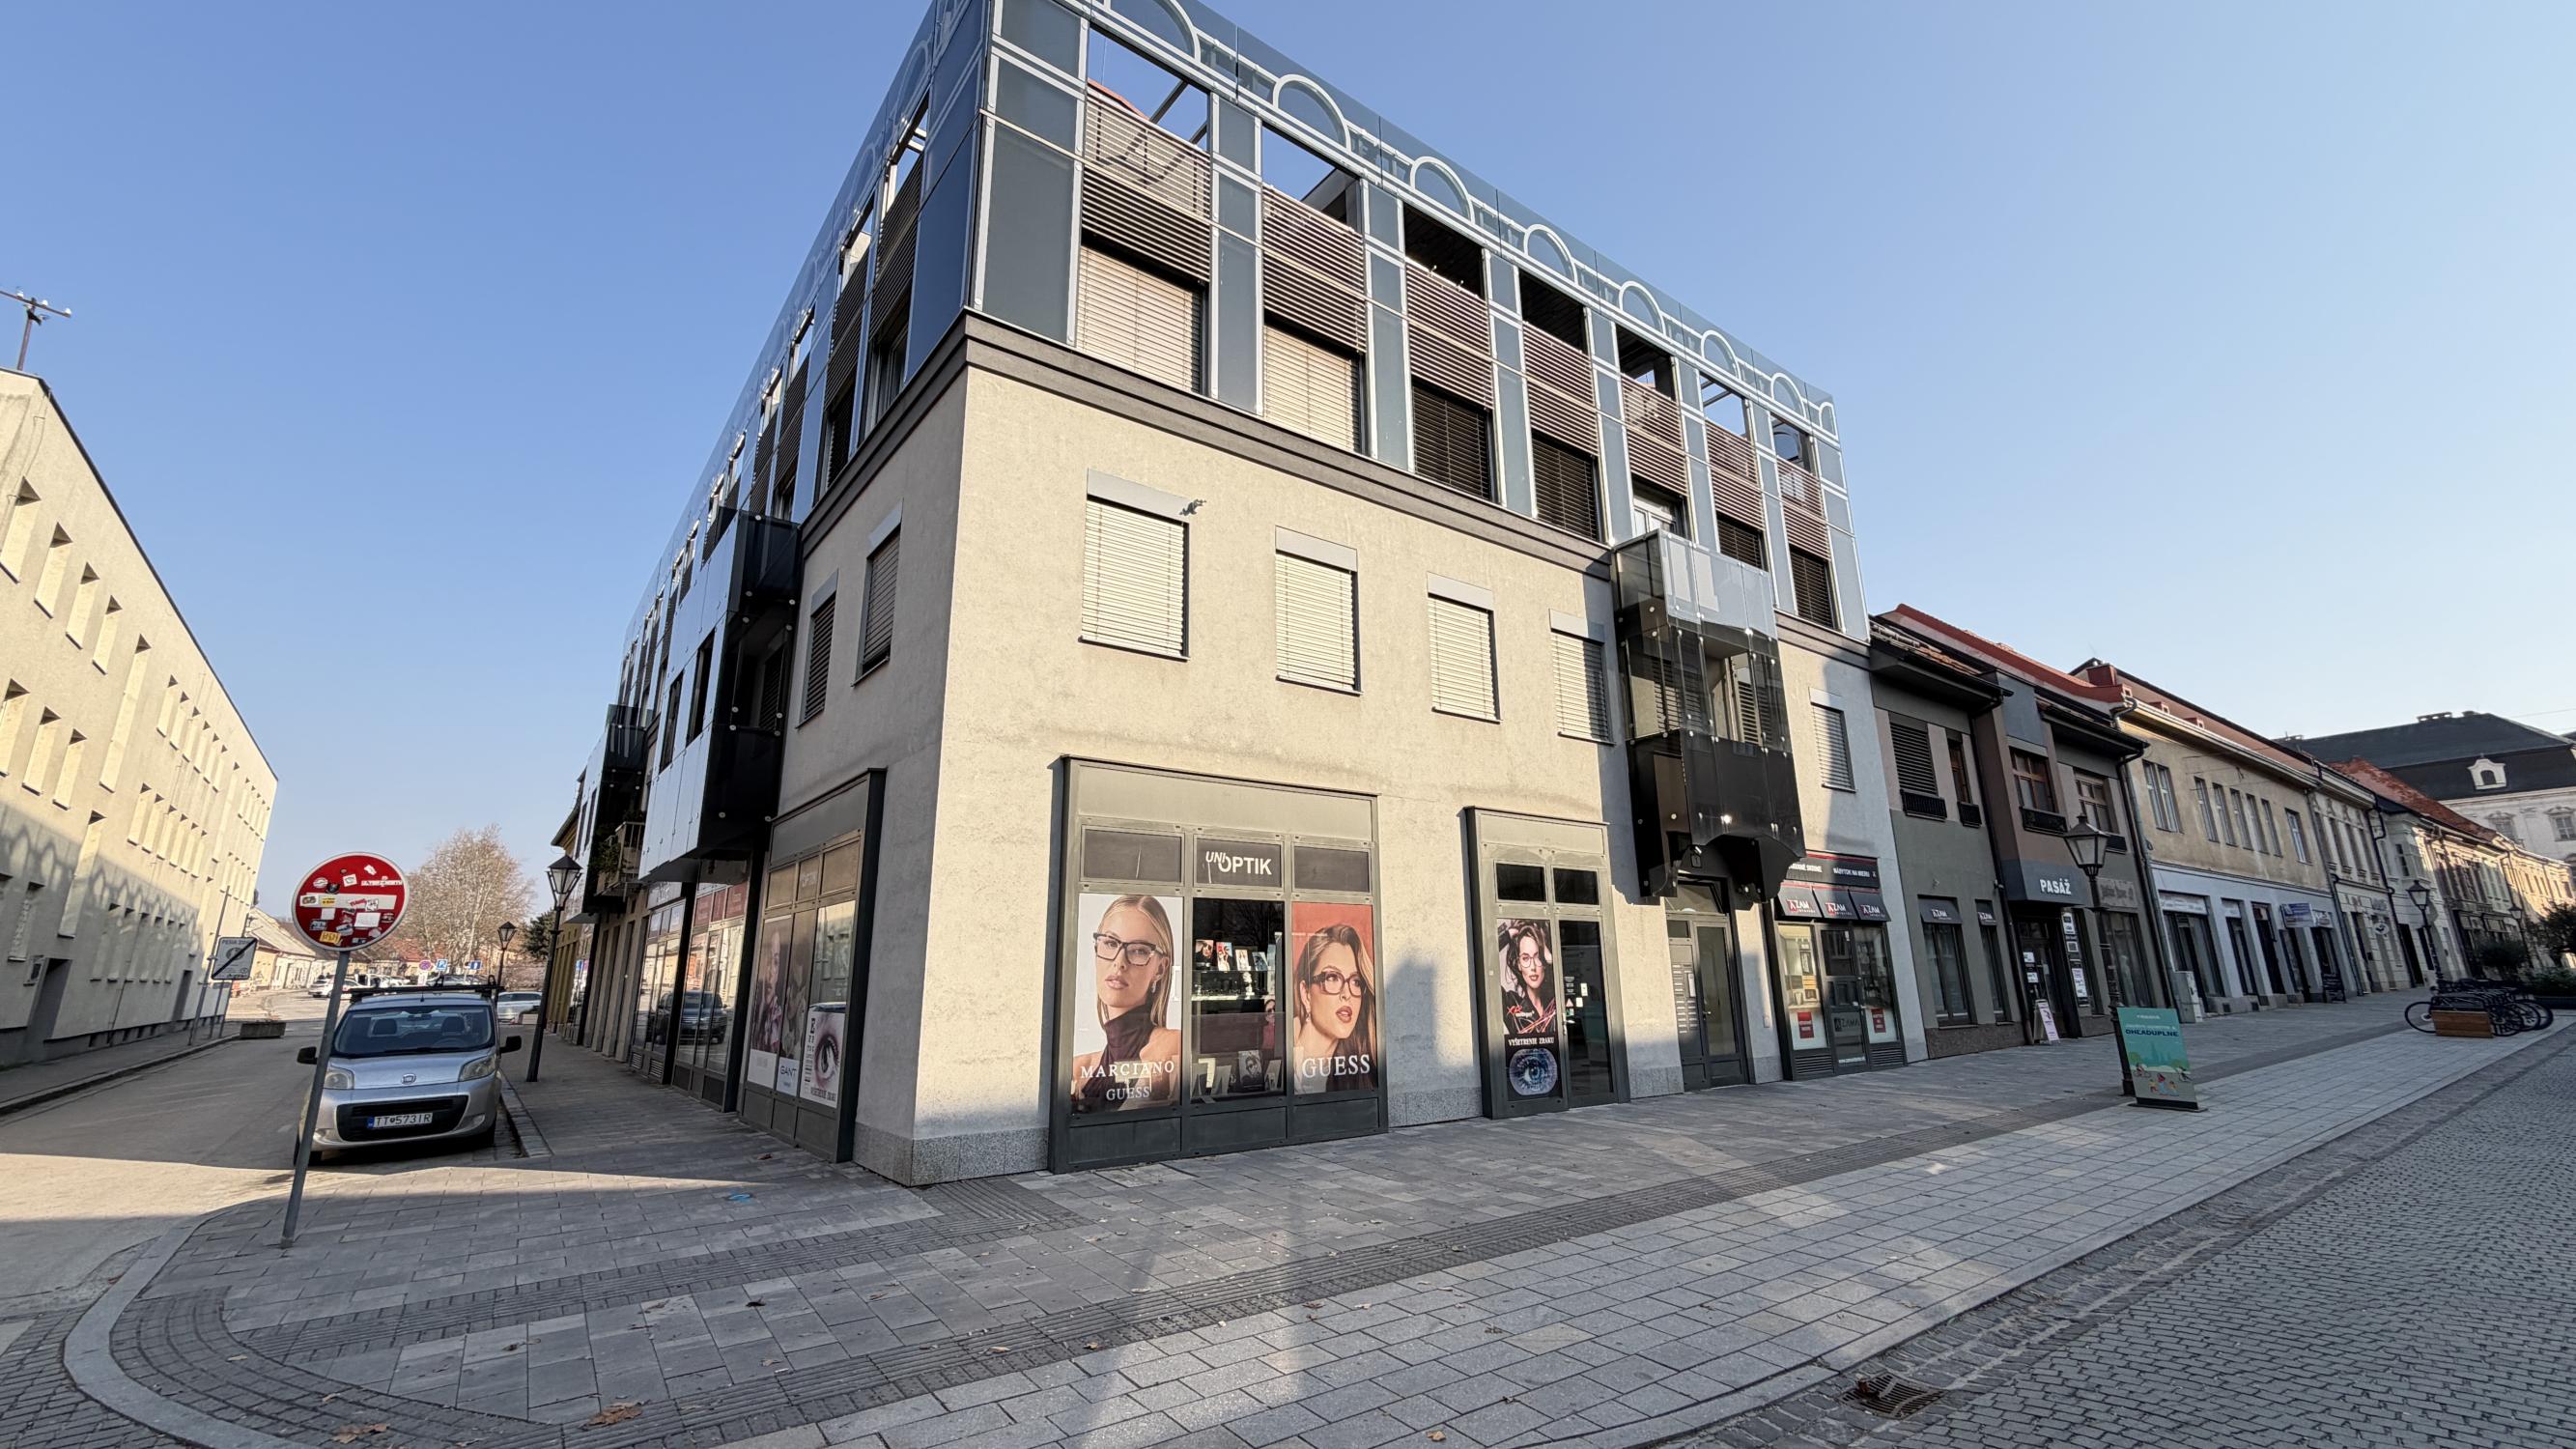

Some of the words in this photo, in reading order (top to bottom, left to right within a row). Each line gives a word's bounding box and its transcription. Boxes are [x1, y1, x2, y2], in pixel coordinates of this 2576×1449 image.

[2039, 877, 2072, 895] PASÁŽ
[1081, 1061, 1175, 1078] MARCIANO
[1302, 1054, 1371, 1078] GUESS
[1106, 1086, 1151, 1101] GUESS
